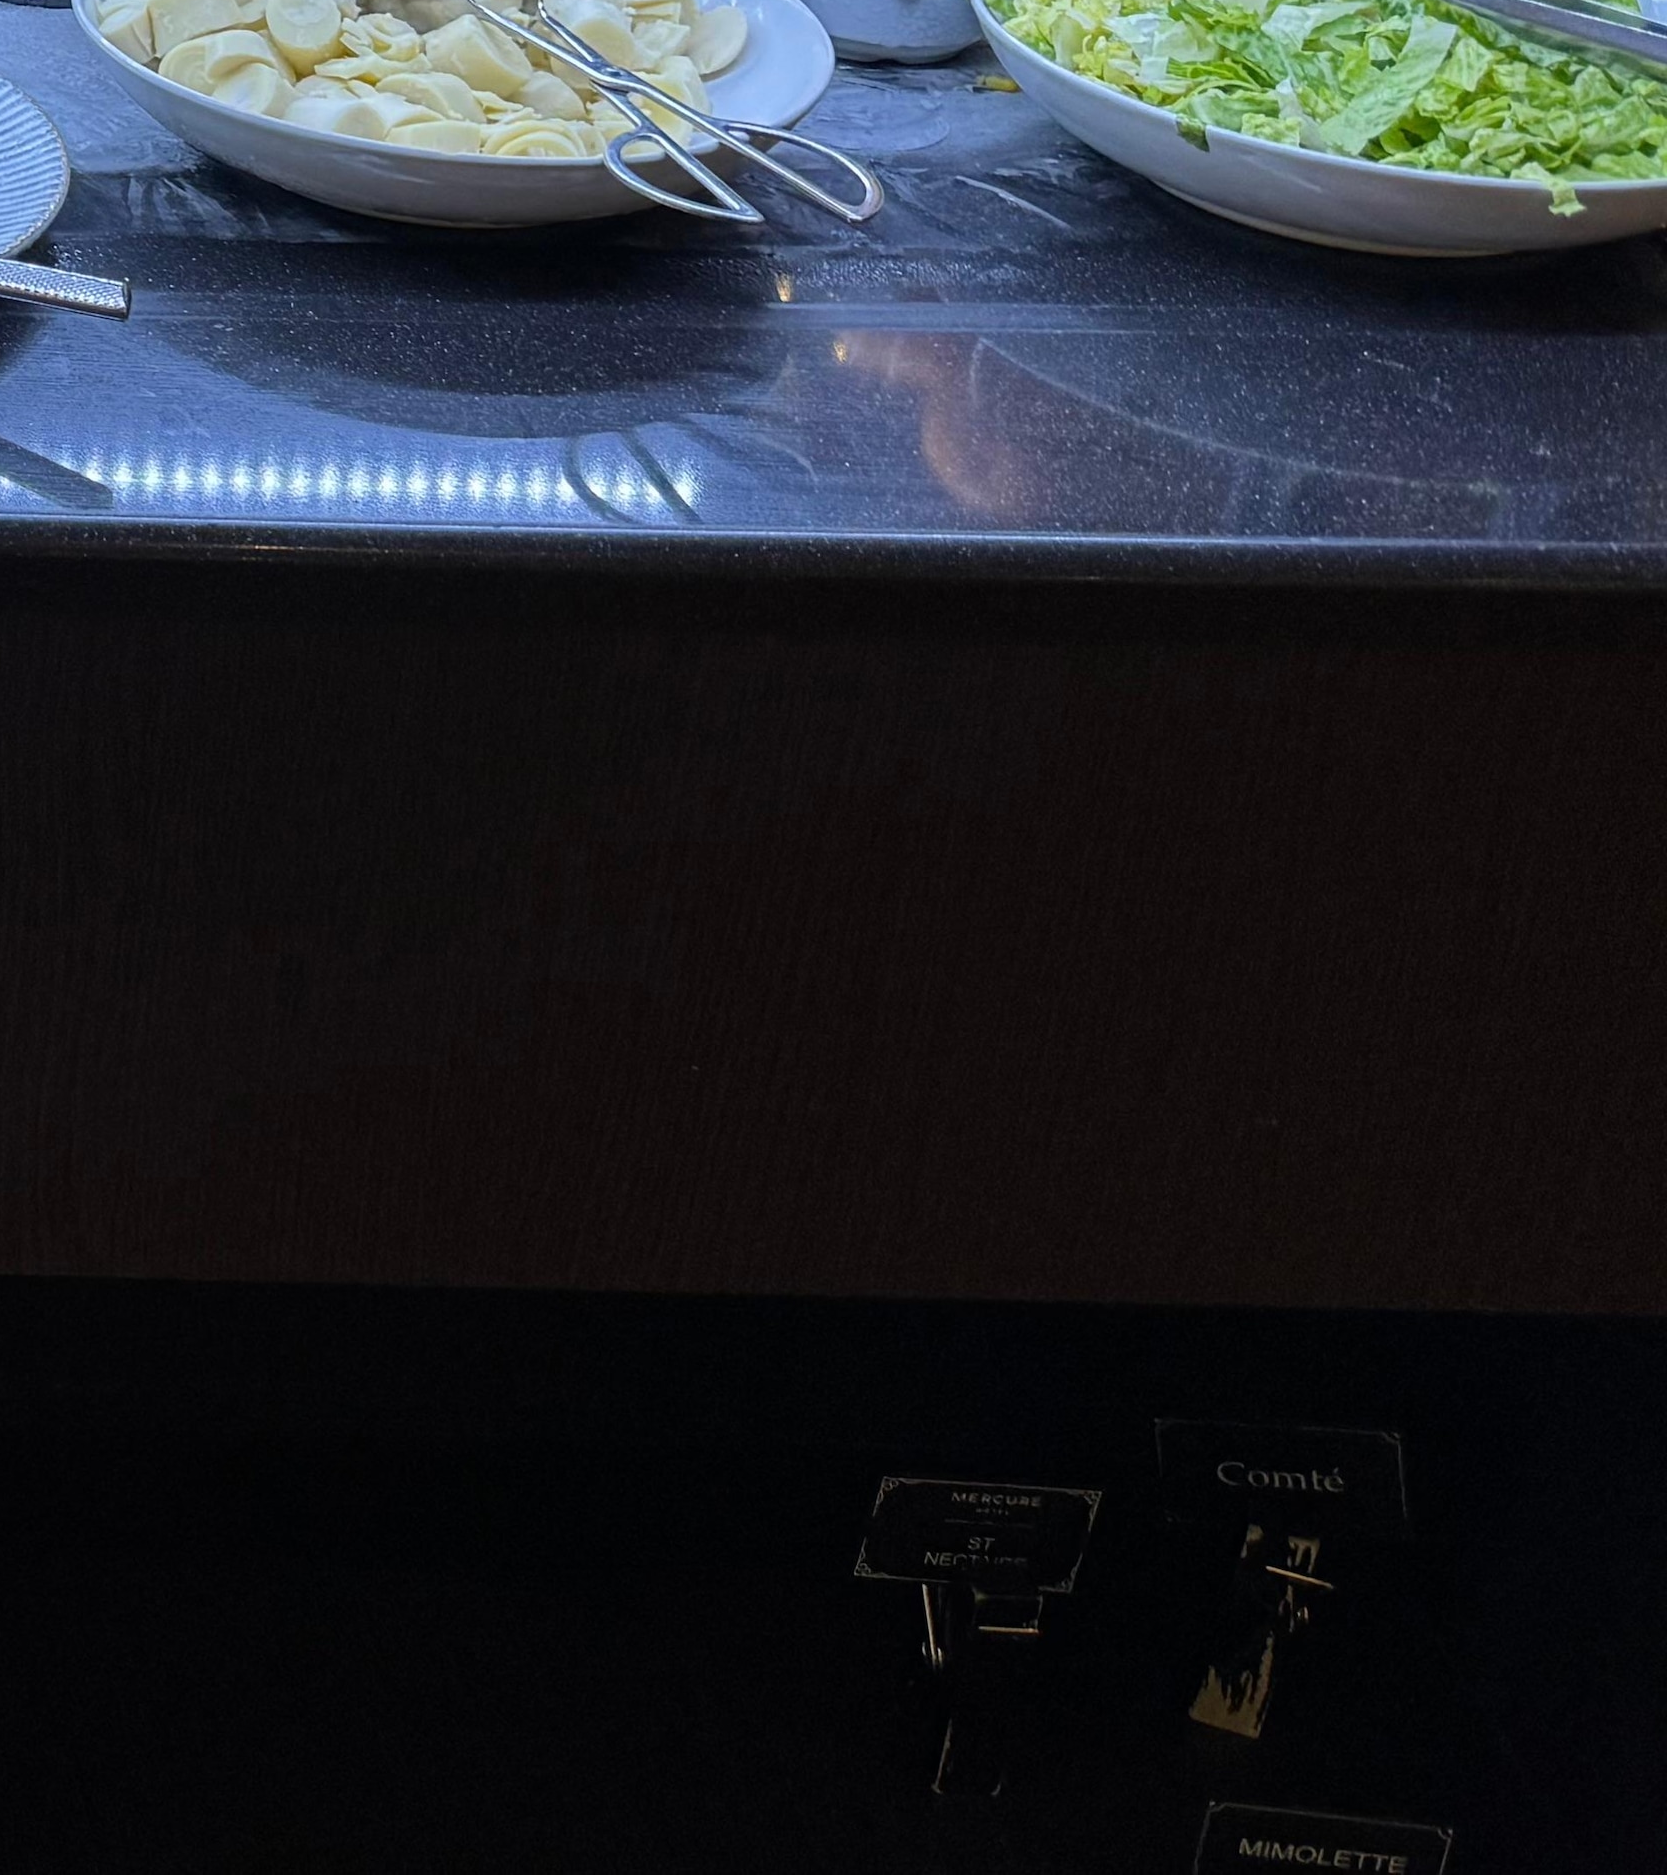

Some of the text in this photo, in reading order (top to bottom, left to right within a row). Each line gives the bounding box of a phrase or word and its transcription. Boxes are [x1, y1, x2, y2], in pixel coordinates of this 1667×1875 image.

[1217, 1461, 1344, 1493] Comté
[951, 1491, 1042, 1507] MERCURE
[968, 1536, 996, 1552] ST
[1238, 1837, 1409, 1875] MIMOLETTE
